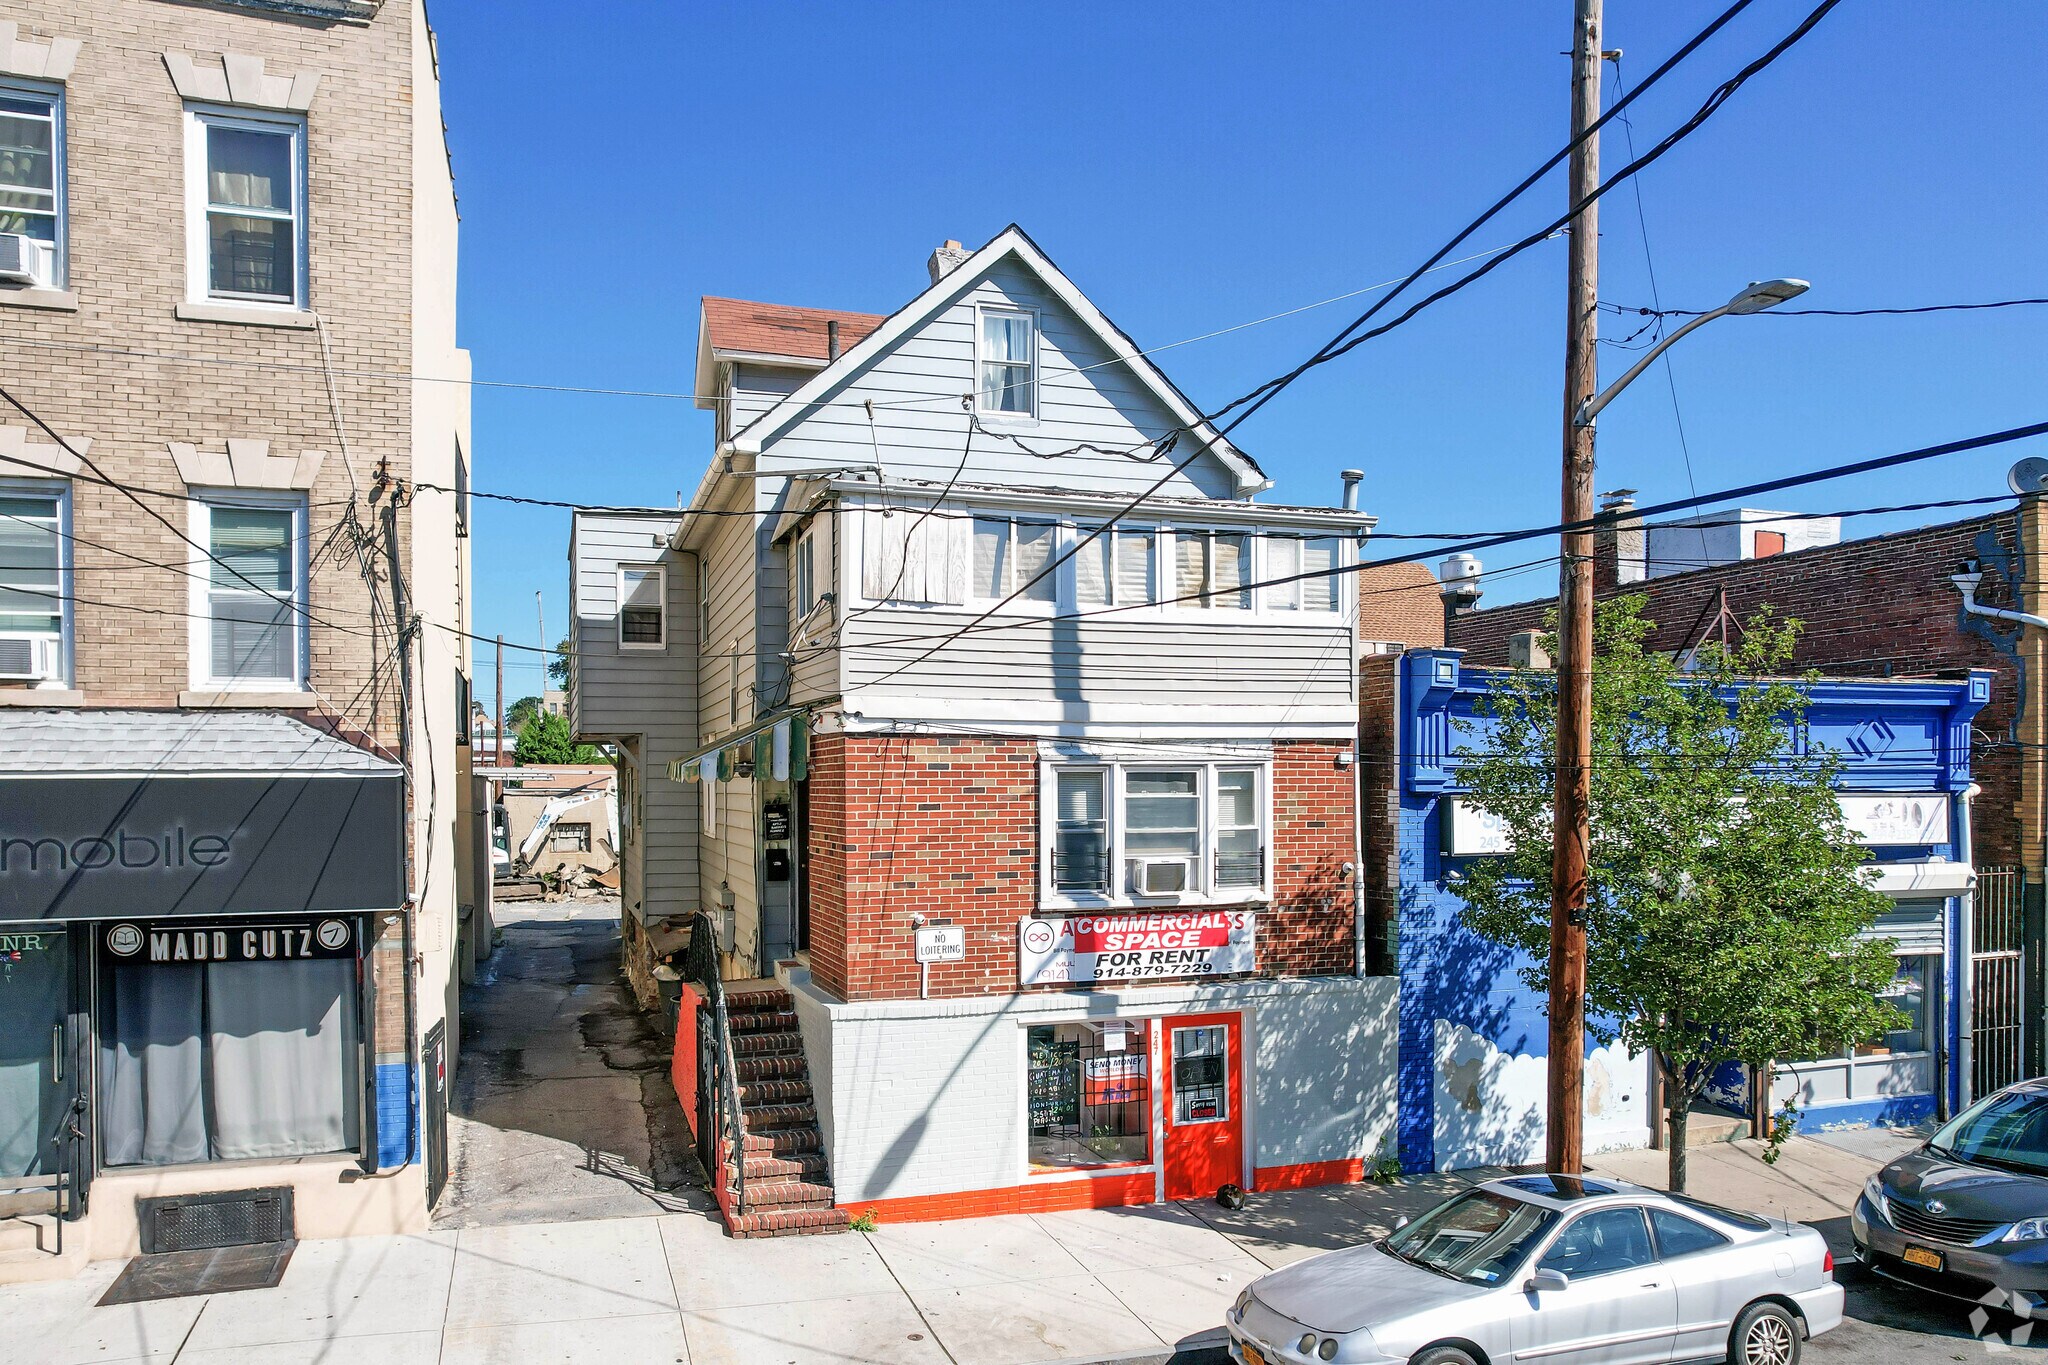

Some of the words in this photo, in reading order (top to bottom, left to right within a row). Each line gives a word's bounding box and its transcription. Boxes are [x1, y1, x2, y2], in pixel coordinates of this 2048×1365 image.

[1, 826, 230, 871] mobile
[1479, 836, 1501, 849] 245
[1077, 913, 1226, 935] COMMERCIAL
[150, 930, 228, 962] MADD
[242, 929, 313, 958] CUTZ
[934, 934, 946, 944] NO
[1103, 930, 1202, 951] SPACE
[920, 944, 961, 956] LOITERING
[1095, 952, 1142, 968] FOR
[1149, 948, 1211, 965] RENT
[1037, 968, 1070, 981] (914)
[1092, 963, 1213, 979] 914-879-7229
[1153, 1030, 1161, 1056] 247
[1089, 1060, 1111, 1070] SEND
[1113, 1057, 1144, 1068] MONEY
[1181, 1063, 1219, 1080] OPEN
[1191, 1107, 1216, 1117] CLOSED
